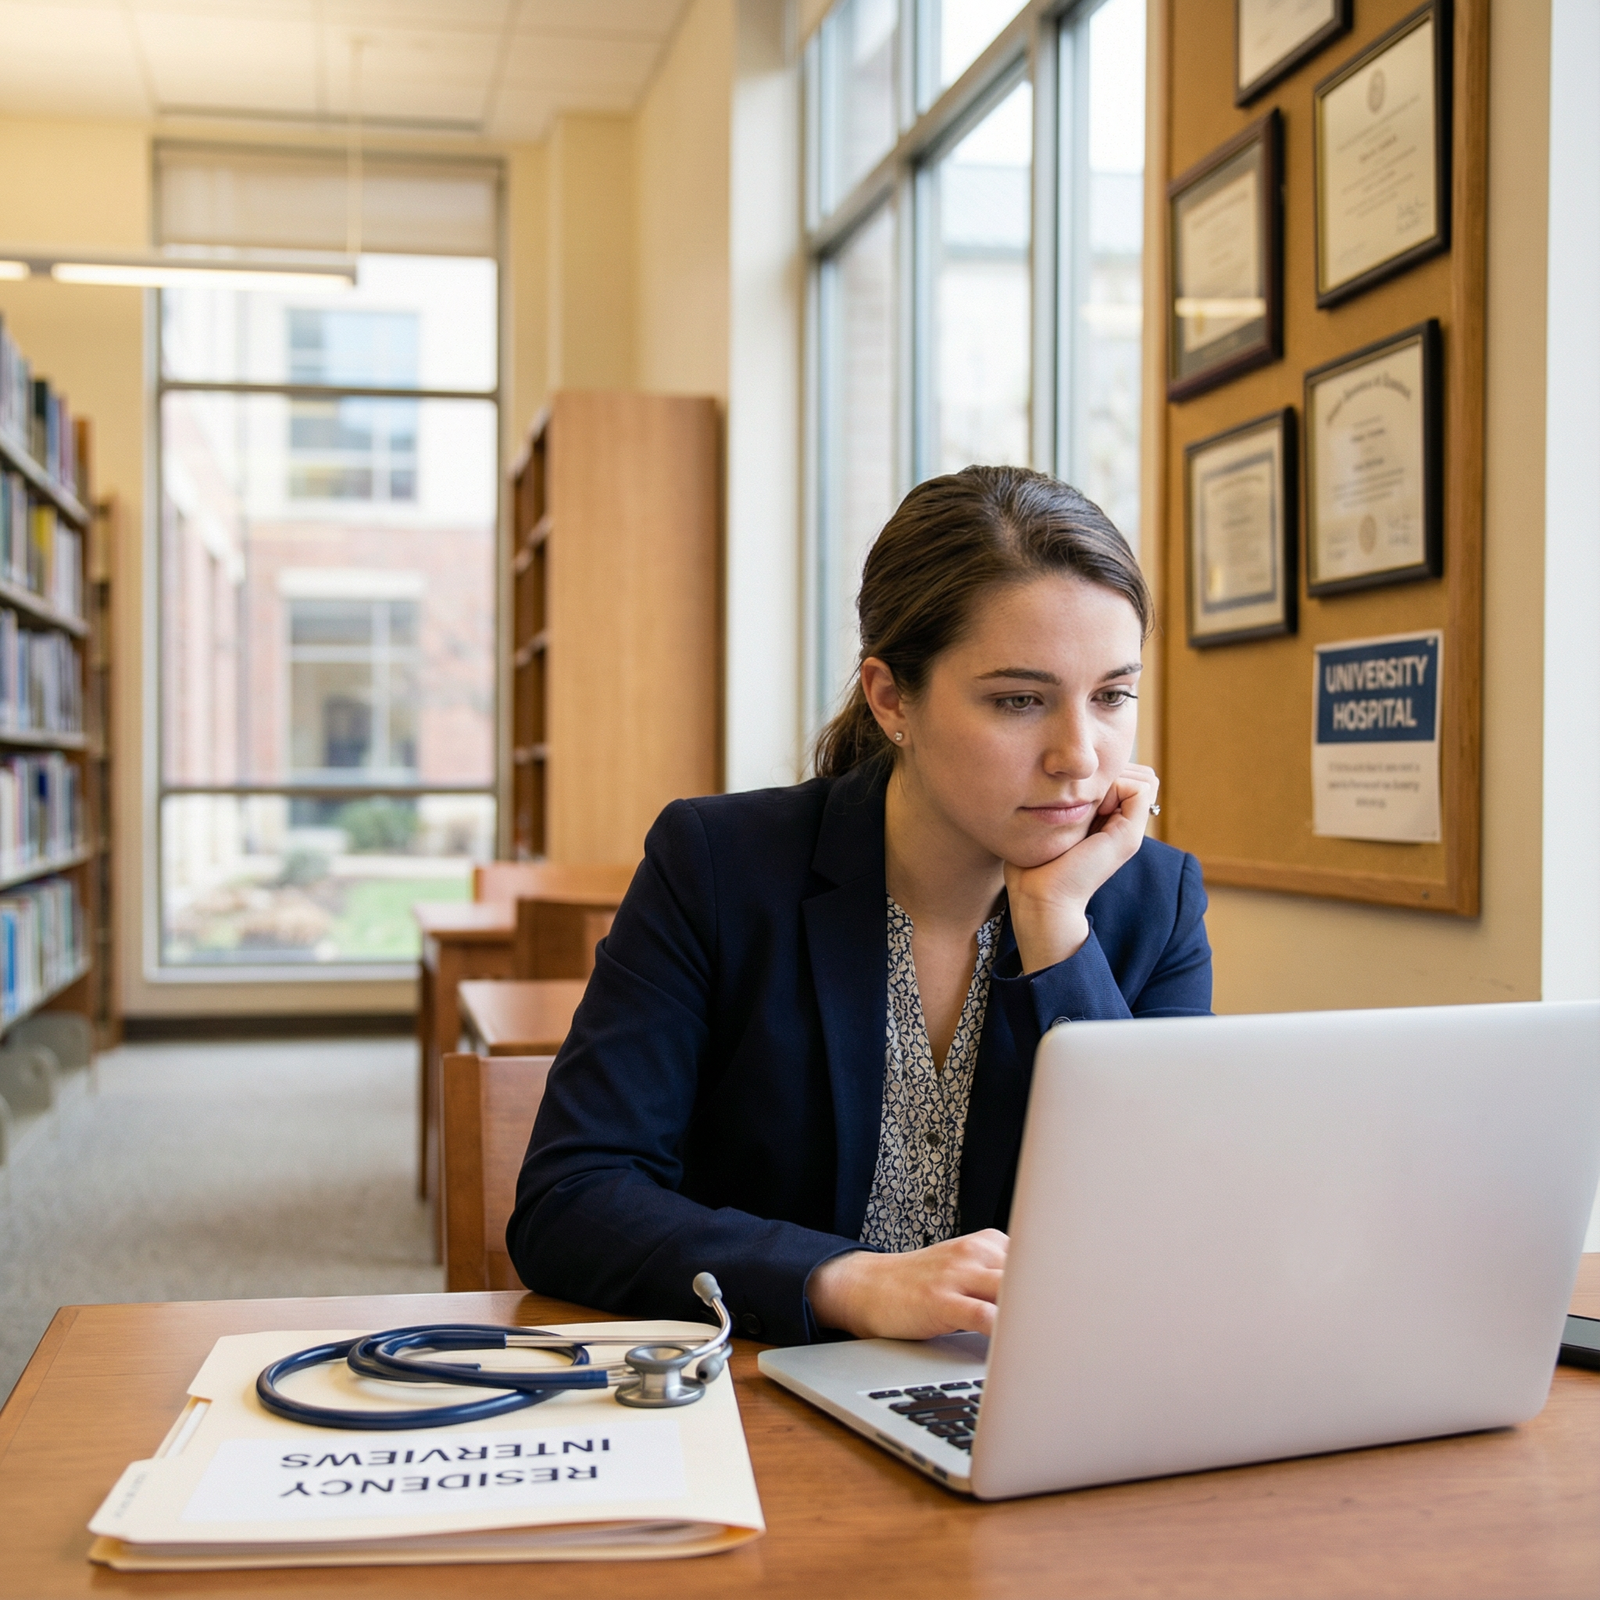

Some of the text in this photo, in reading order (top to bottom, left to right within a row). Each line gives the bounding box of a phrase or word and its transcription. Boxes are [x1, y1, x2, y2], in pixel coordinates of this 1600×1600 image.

[1324, 654, 1429, 694] UNIVERSITY
[1332, 697, 1418, 731] HOSPITAL
[279, 1438, 611, 1469] INTERVIEWS
[279, 1465, 599, 1498] RESIDENCY
